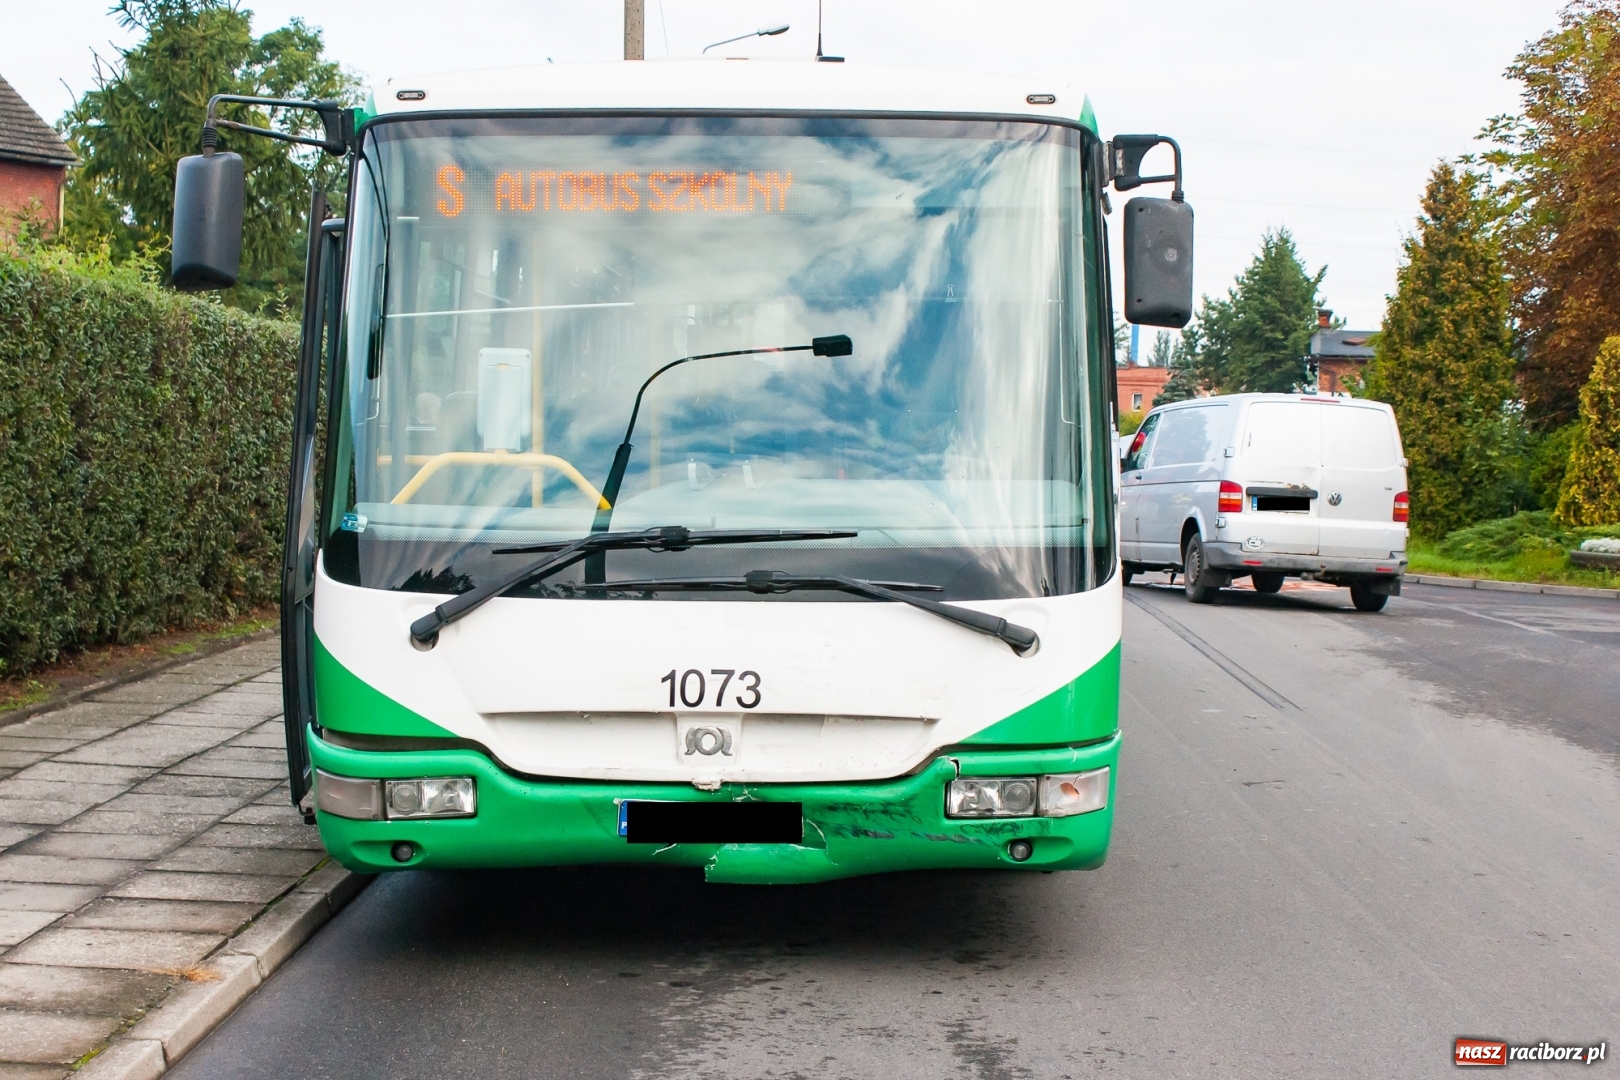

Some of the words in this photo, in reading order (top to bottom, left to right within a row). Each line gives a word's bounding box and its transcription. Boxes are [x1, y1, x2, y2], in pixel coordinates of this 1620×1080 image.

[437, 165, 465, 217] S
[495, 170, 640, 211] AUTOBUS
[648, 170, 793, 211] SZKOLNY
[661, 669, 762, 708] 1073
